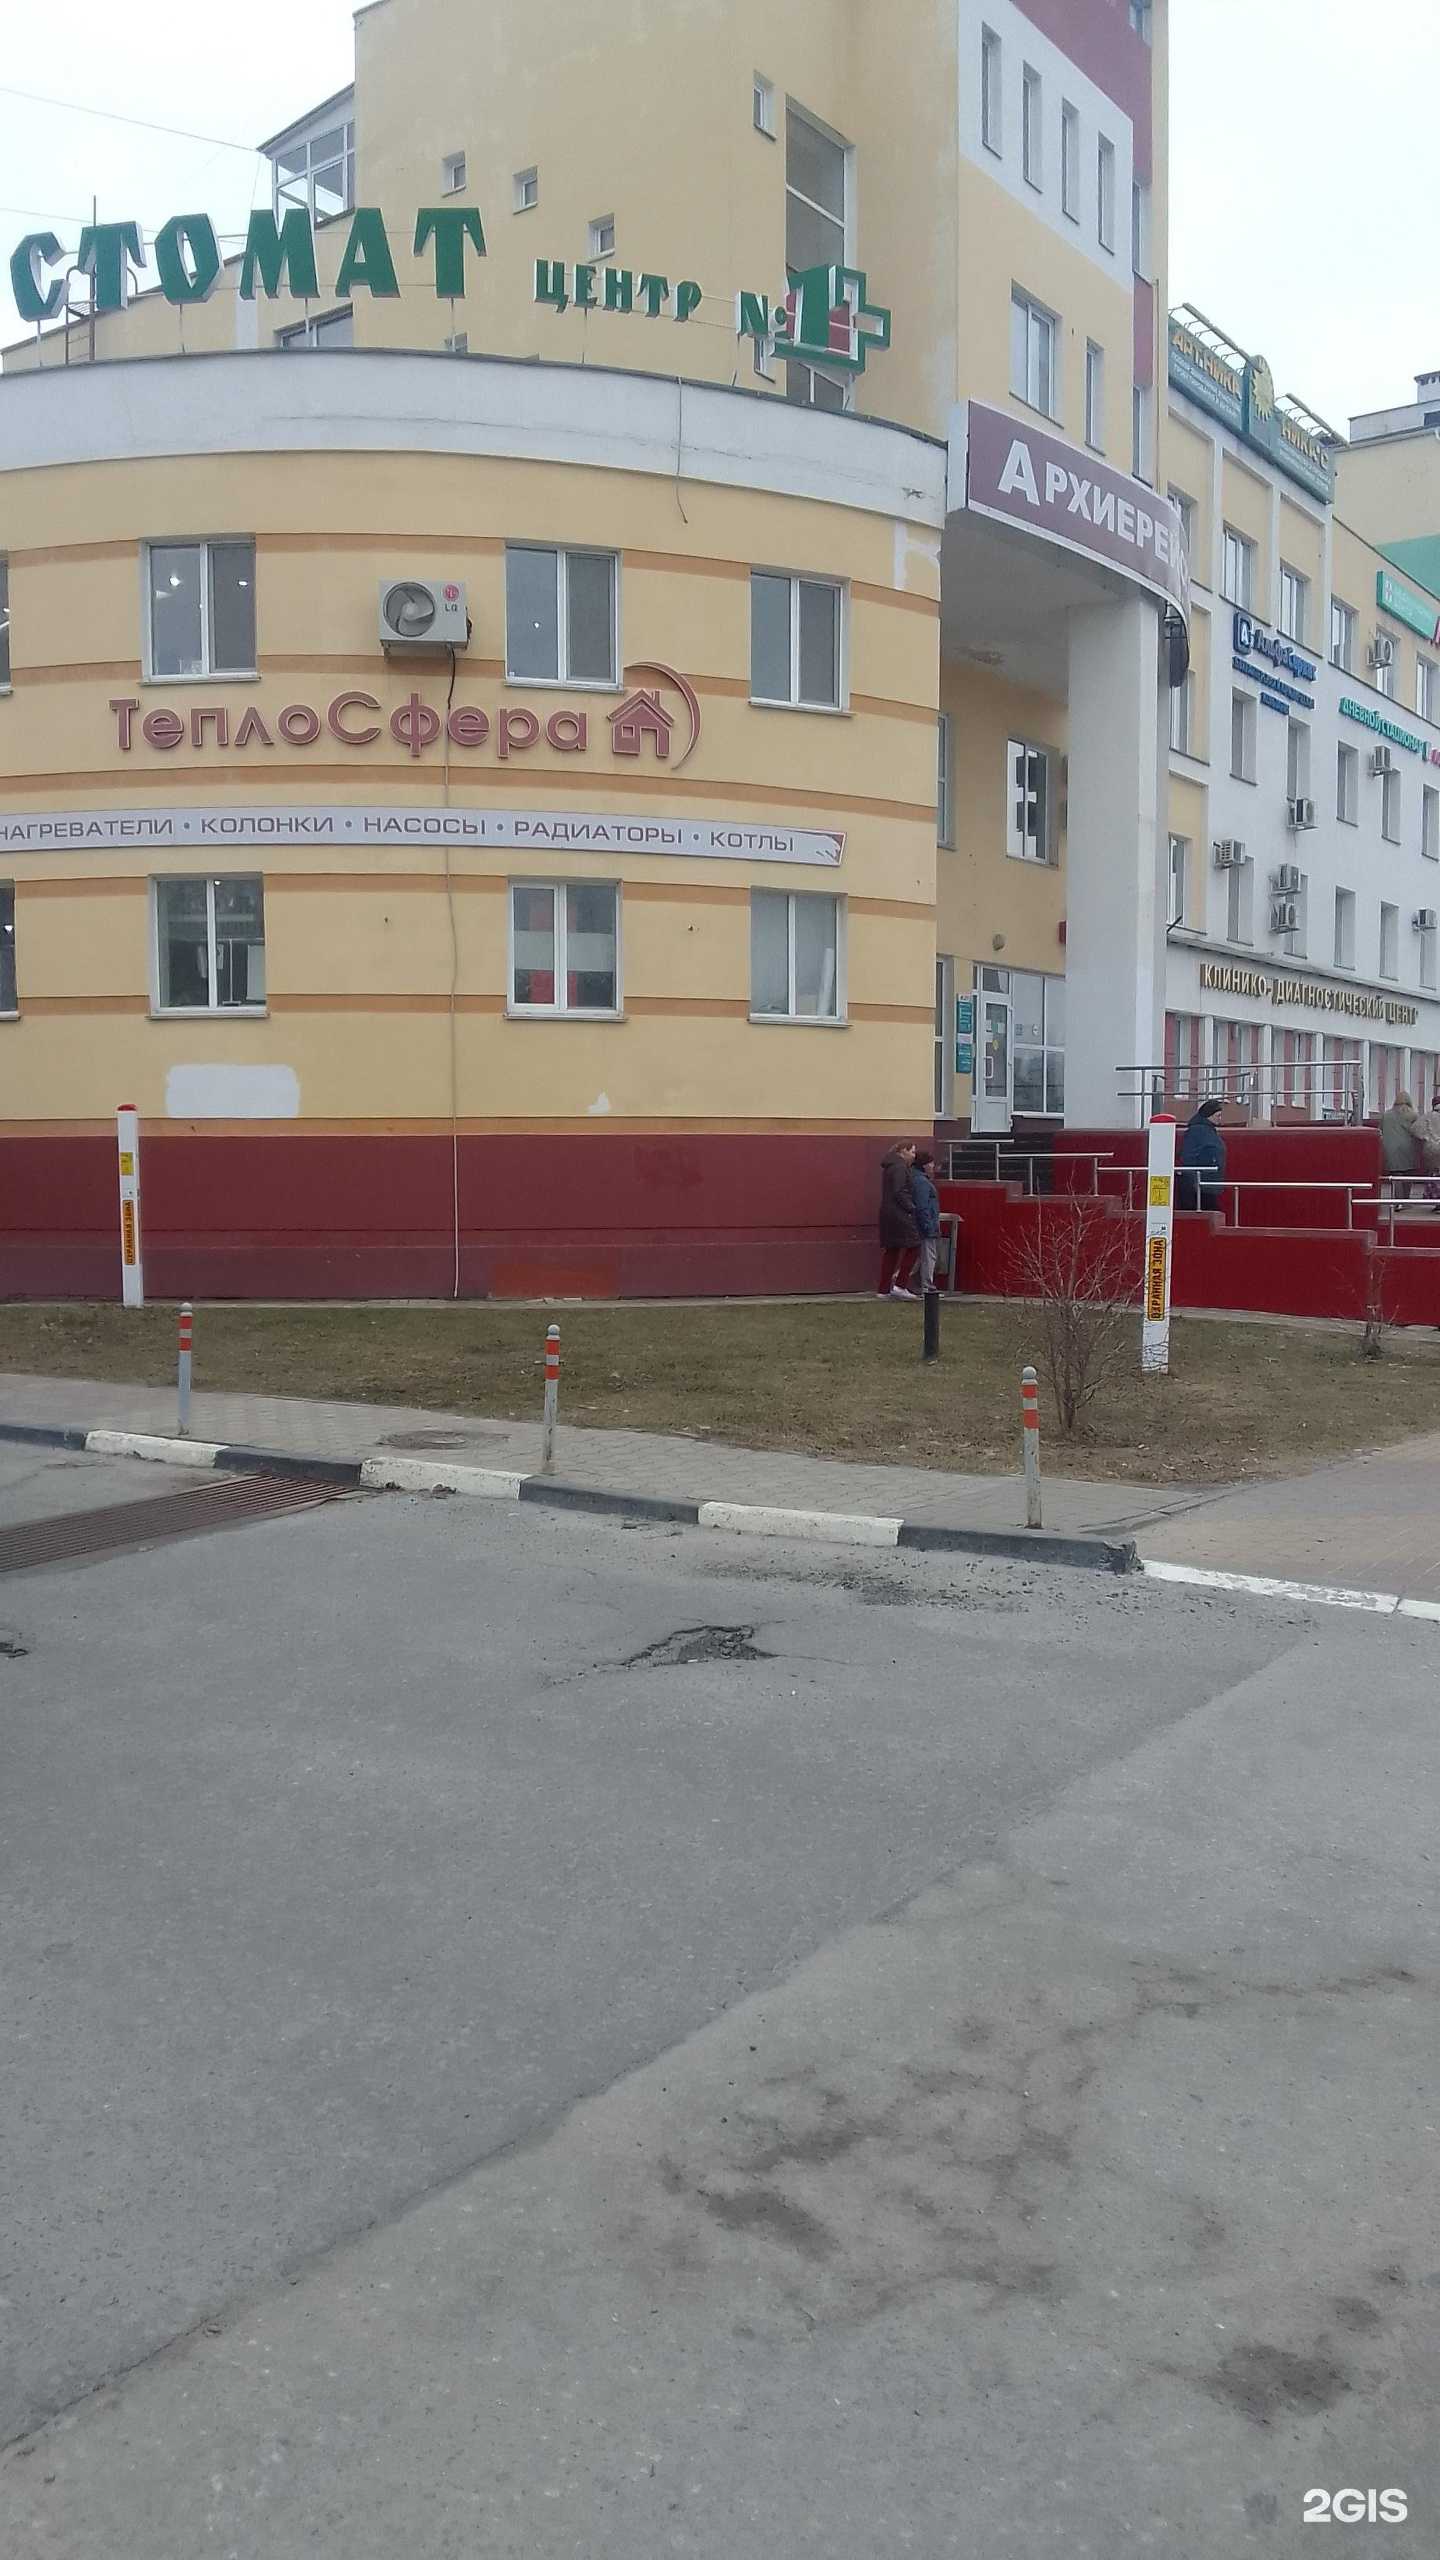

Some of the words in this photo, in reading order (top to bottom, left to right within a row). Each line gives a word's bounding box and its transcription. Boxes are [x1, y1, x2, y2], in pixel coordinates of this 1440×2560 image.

[10, 207, 487, 322] СТОМАТ
[534, 258, 703, 323] ЦЕНТР
[109, 690, 588, 758] ТеплоСфера
[0, 818, 173, 841] НАГРЕВАТЕЛИ
[200, 816, 334, 834] КОЛОНКИ
[363, 816, 486, 836] НАСОСЫ
[513, 819, 683, 846] РАДИАТОРЫ
[710, 830, 794, 853] КОТЛЫ
[1152, 1240, 1164, 1264] ЗОНА
[1151, 1268, 1162, 1318] ОХРАННАЯ
